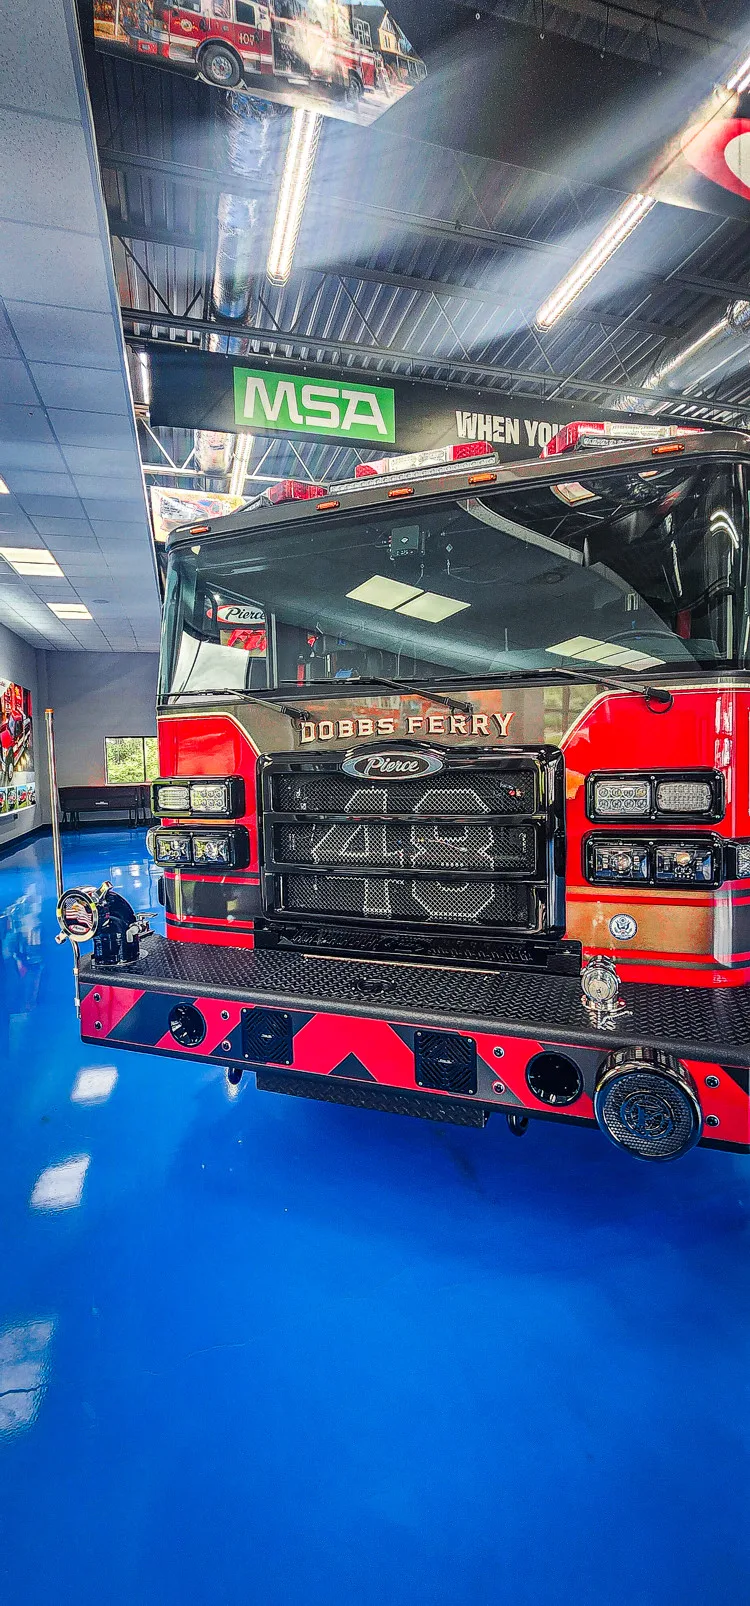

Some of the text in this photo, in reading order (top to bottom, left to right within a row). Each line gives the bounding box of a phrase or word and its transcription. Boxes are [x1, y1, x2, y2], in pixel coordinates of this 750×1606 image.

[243, 376, 388, 435] MSA
[455, 410, 520, 445] WHEN
[224, 607, 266, 620] Pierce
[299, 710, 515, 745] DOBBS FERRY
[363, 756, 420, 776] Pierce
[311, 788, 496, 924] 48
